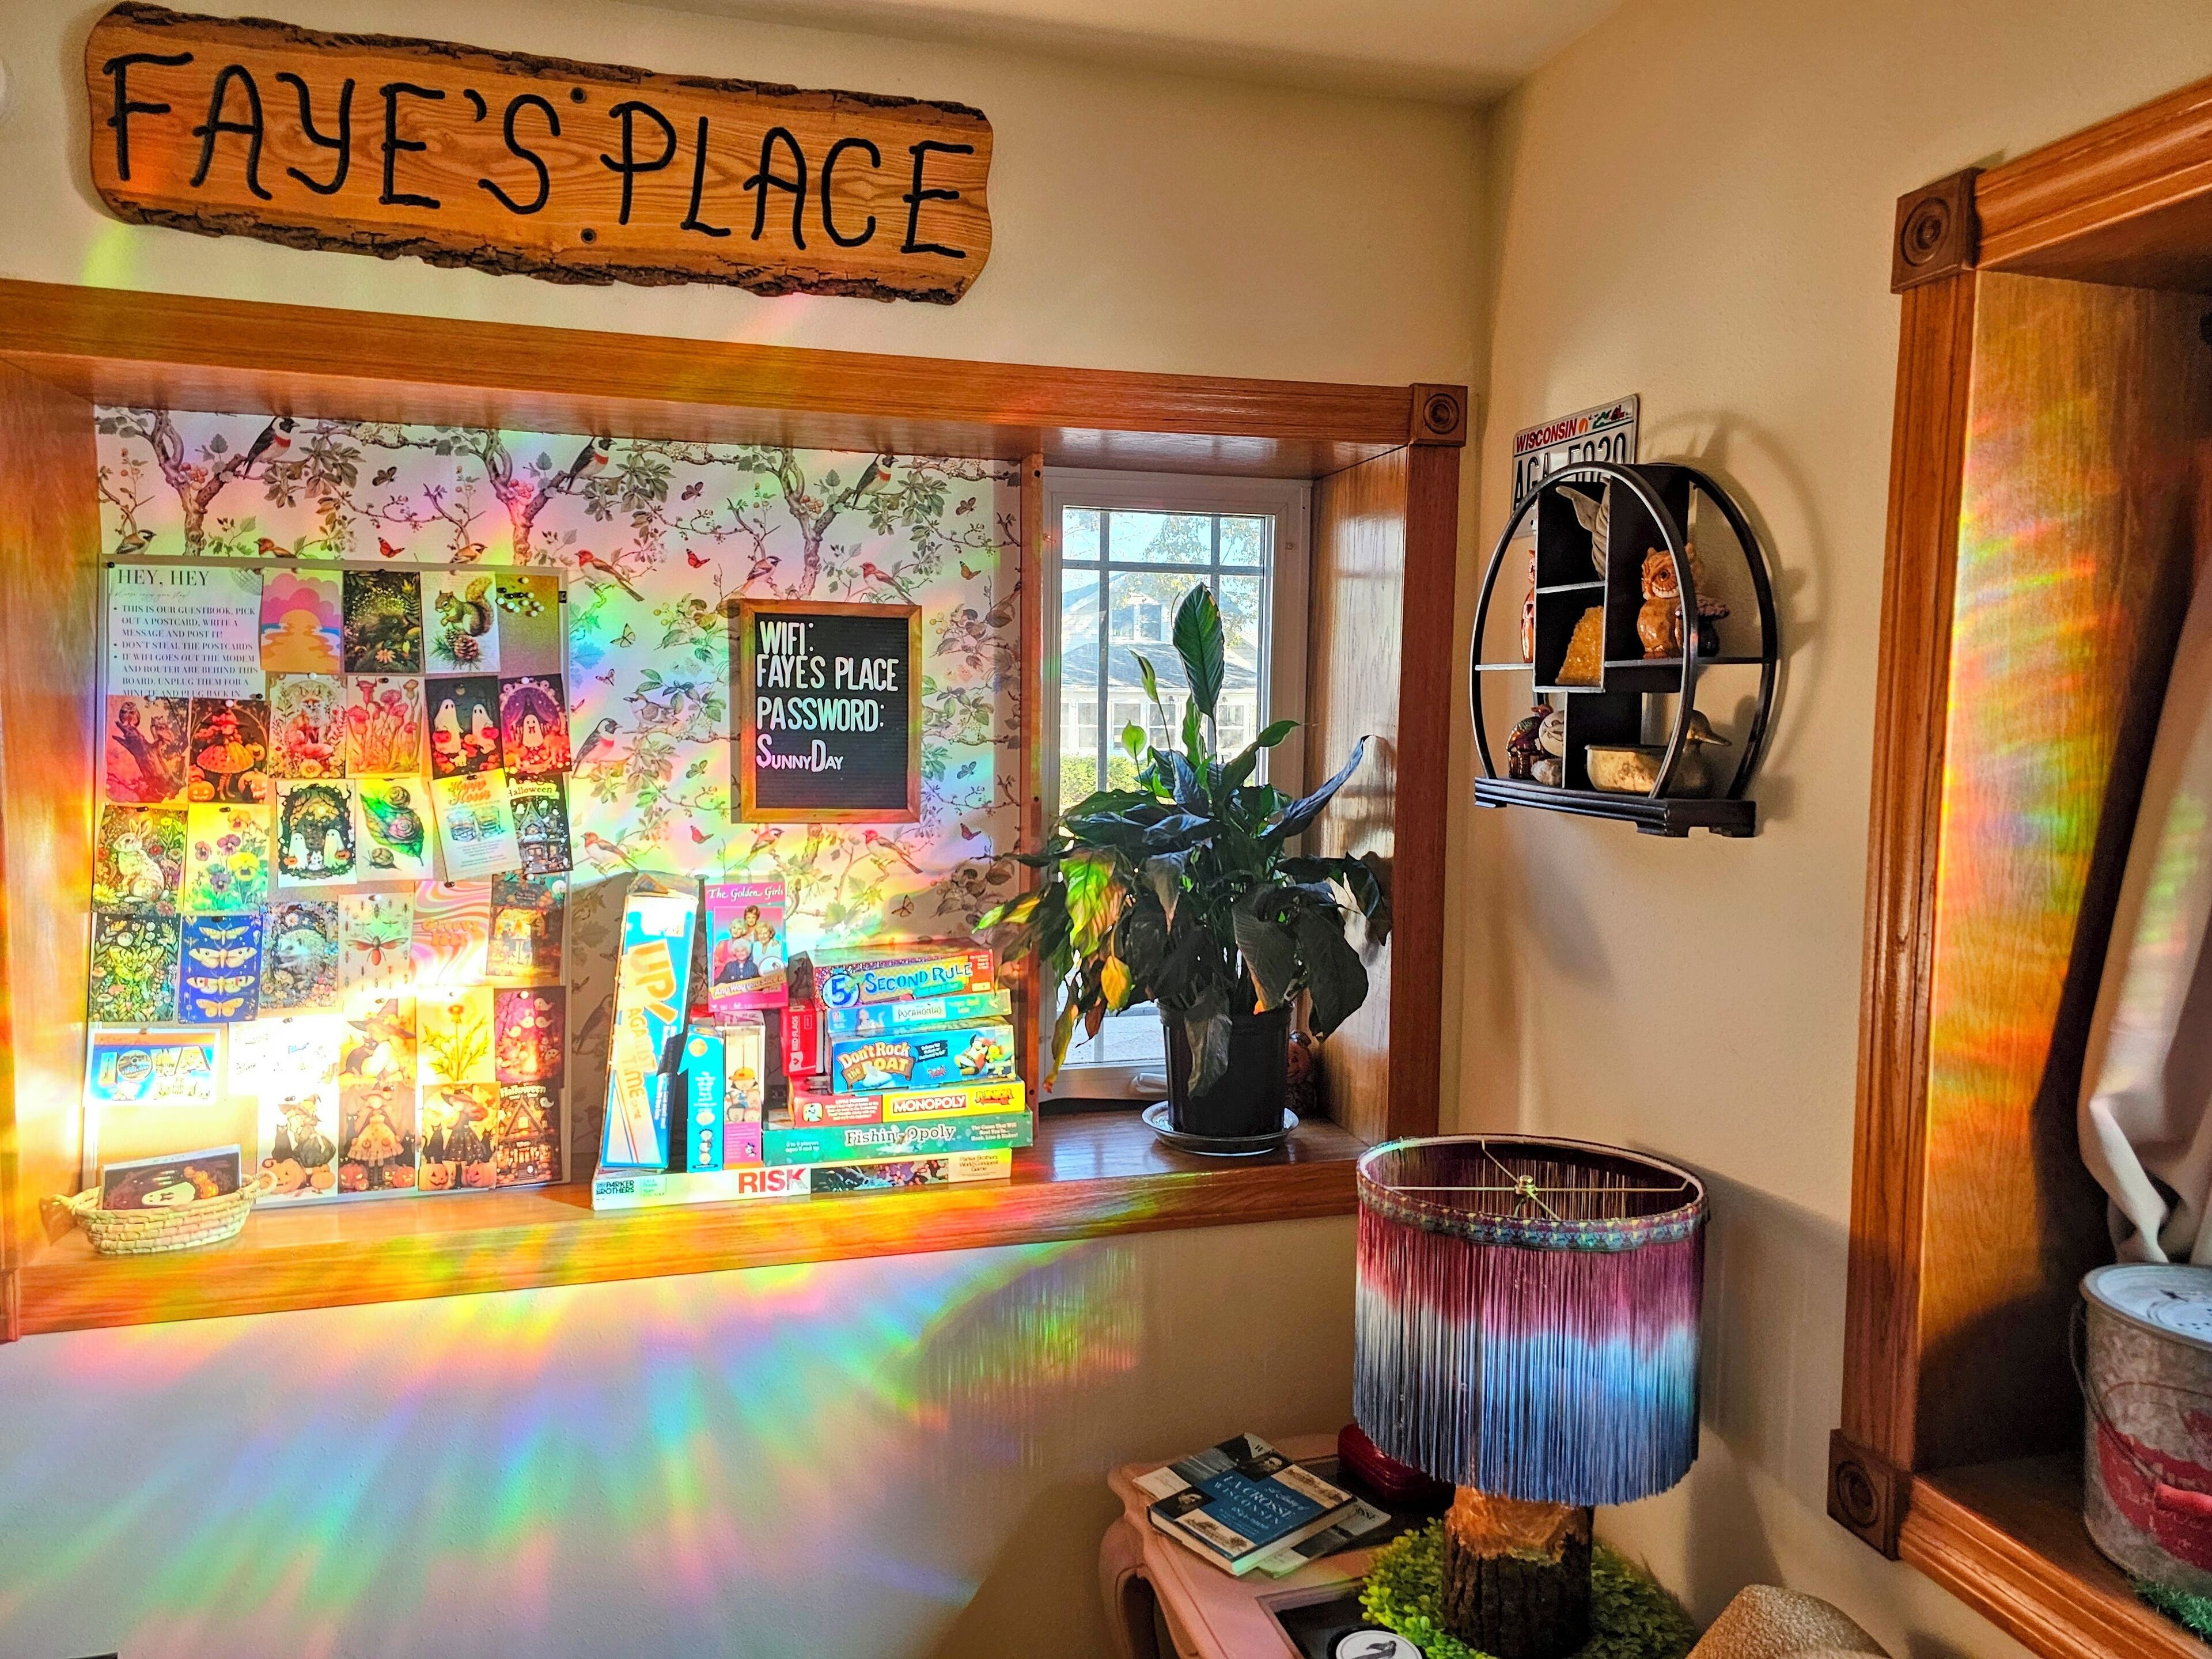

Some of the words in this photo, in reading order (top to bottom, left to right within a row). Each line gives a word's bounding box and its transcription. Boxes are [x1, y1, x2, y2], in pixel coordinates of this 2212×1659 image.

[103, 52, 561, 215] FAYE'S
[599, 100, 975, 259] PLACE
[1516, 418, 1577, 453] WISCONSIN
[118, 569, 163, 586] HEY,
[171, 570, 210, 586] HEY
[157, 605, 176, 613] OUR
[203, 619, 231, 627] WRITE
[166, 630, 185, 638] AND
[759, 620, 815, 656] WIFI:
[202, 642, 253, 650] POSTCARDS
[222, 654, 255, 662] MODEM
[756, 654, 826, 689] FAYES
[835, 657, 900, 691] PLACE
[756, 696, 885, 732] PASSWORD:
[707, 887, 729, 899] The
[730, 887, 763, 902] Golden
[764, 885, 784, 900] Girls
[831, 977, 852, 1005] 5
[791, 1016, 799, 1037] FLAGS
[99, 1046, 211, 1086] IOWA
[847, 1067, 861, 1080] the
[499, 1085, 547, 1098] Halloween
[893, 1096, 966, 1113] MONOPOLY
[738, 1167, 808, 1194] RISK
